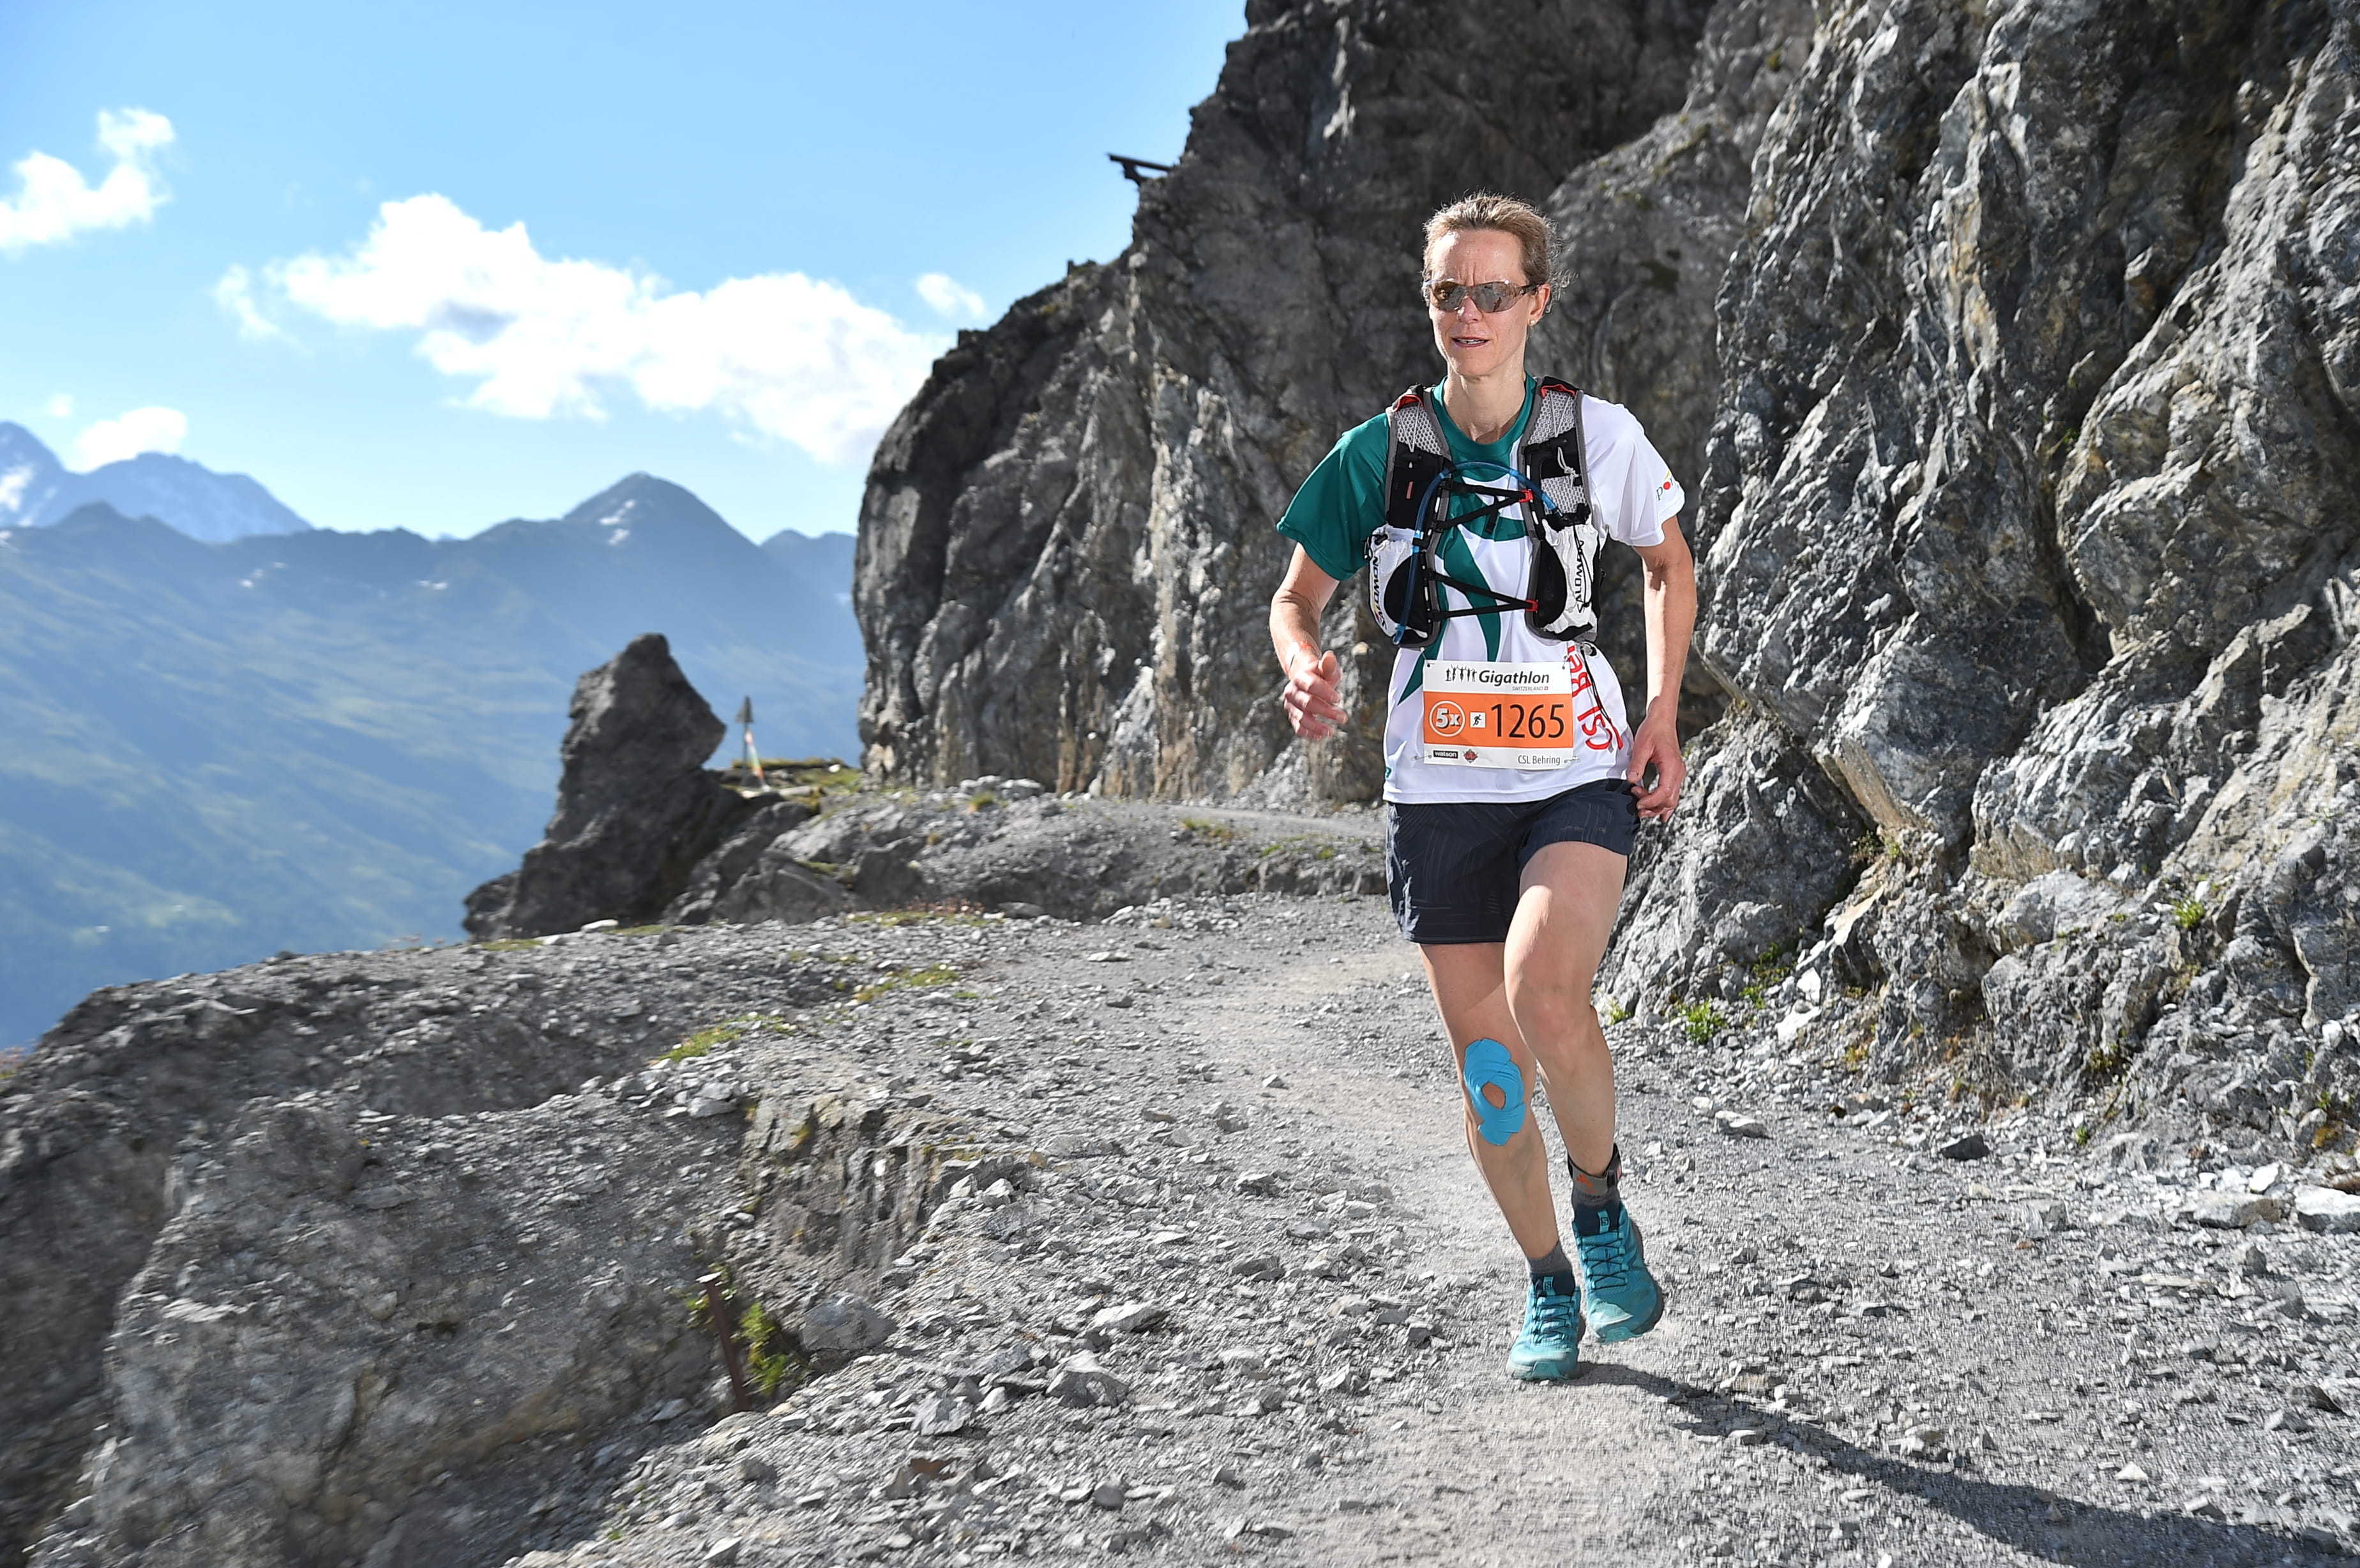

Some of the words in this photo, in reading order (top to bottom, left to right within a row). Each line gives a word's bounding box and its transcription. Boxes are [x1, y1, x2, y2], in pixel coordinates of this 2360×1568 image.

[1479, 670, 1550, 686] Gigathlon
[1435, 705, 1460, 728] 5x
[1491, 704, 1564, 738] 1265
[1518, 755, 1531, 764] CSL
[1532, 755, 1561, 766] Behring
